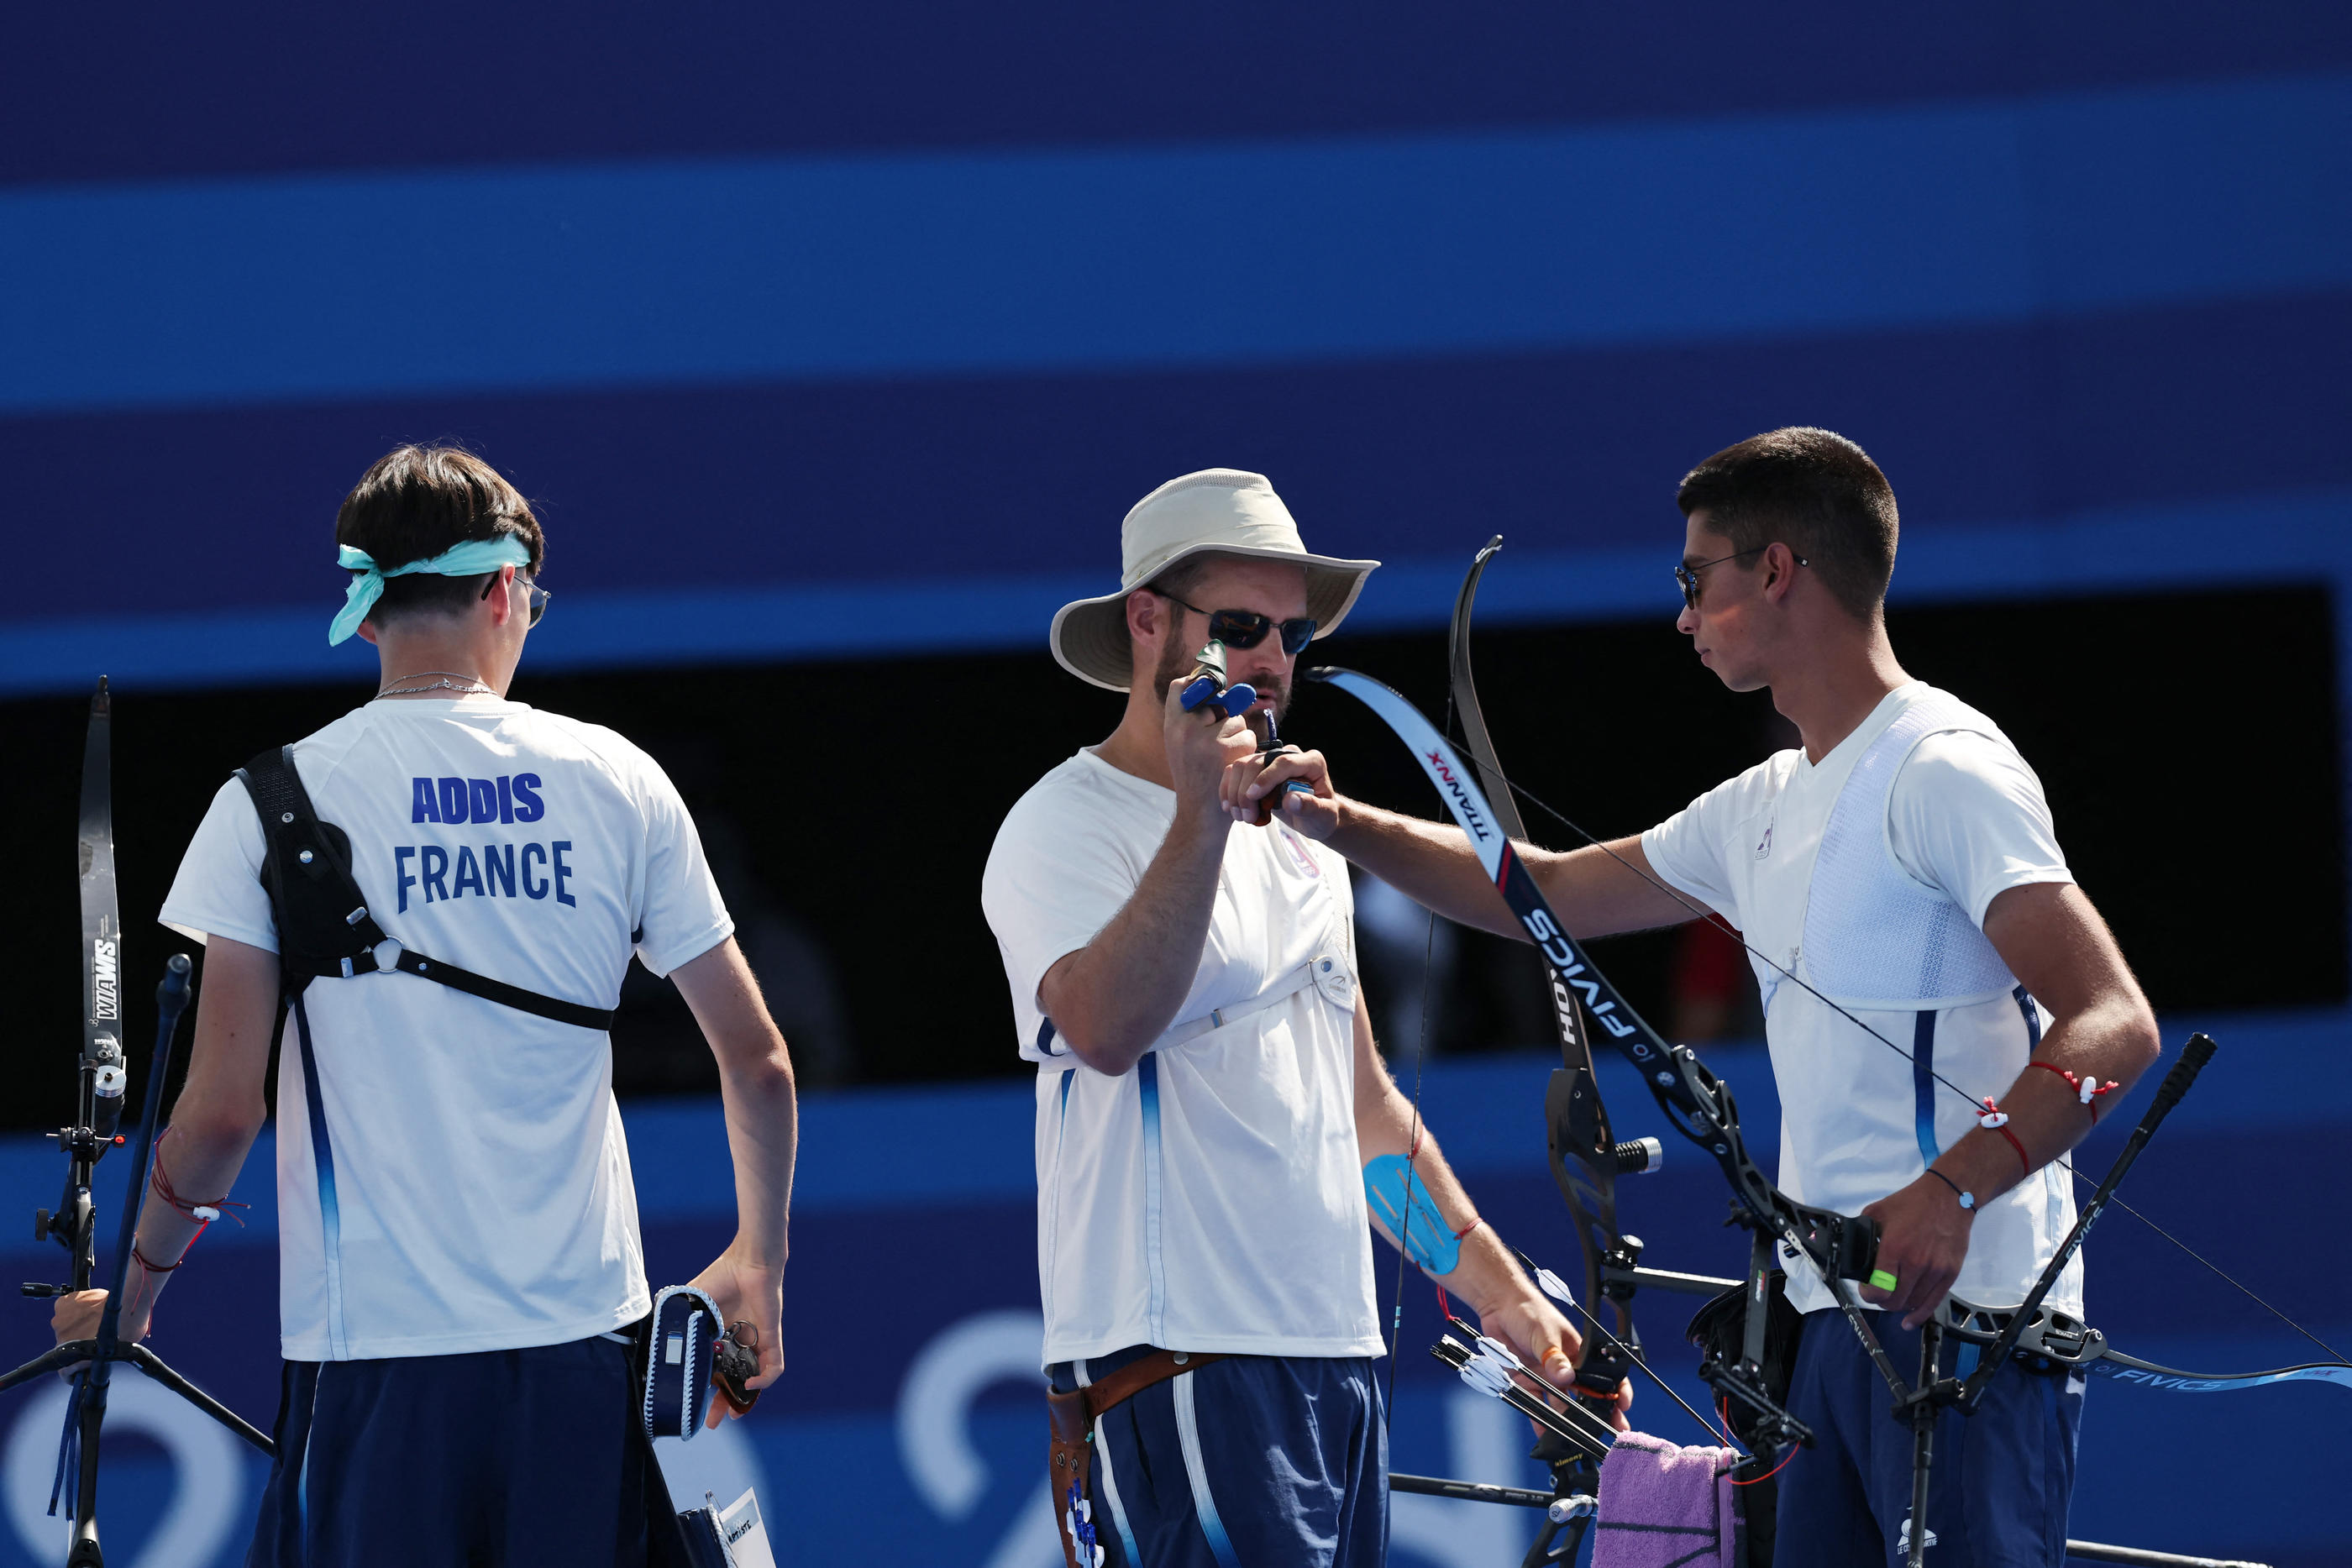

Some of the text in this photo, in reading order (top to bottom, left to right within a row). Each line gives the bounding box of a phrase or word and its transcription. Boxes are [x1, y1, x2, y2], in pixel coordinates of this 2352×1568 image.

[411, 773, 545, 825] ADDIS
[1425, 752, 1489, 842] TITANNX
[394, 841, 576, 915] FRANCE
[94, 939, 117, 1020] WIAWIS
[1522, 909, 1637, 1038] FIVICS
[1550, 968, 1577, 1046] HO
[2113, 1370, 2229, 1391] FIVICS
